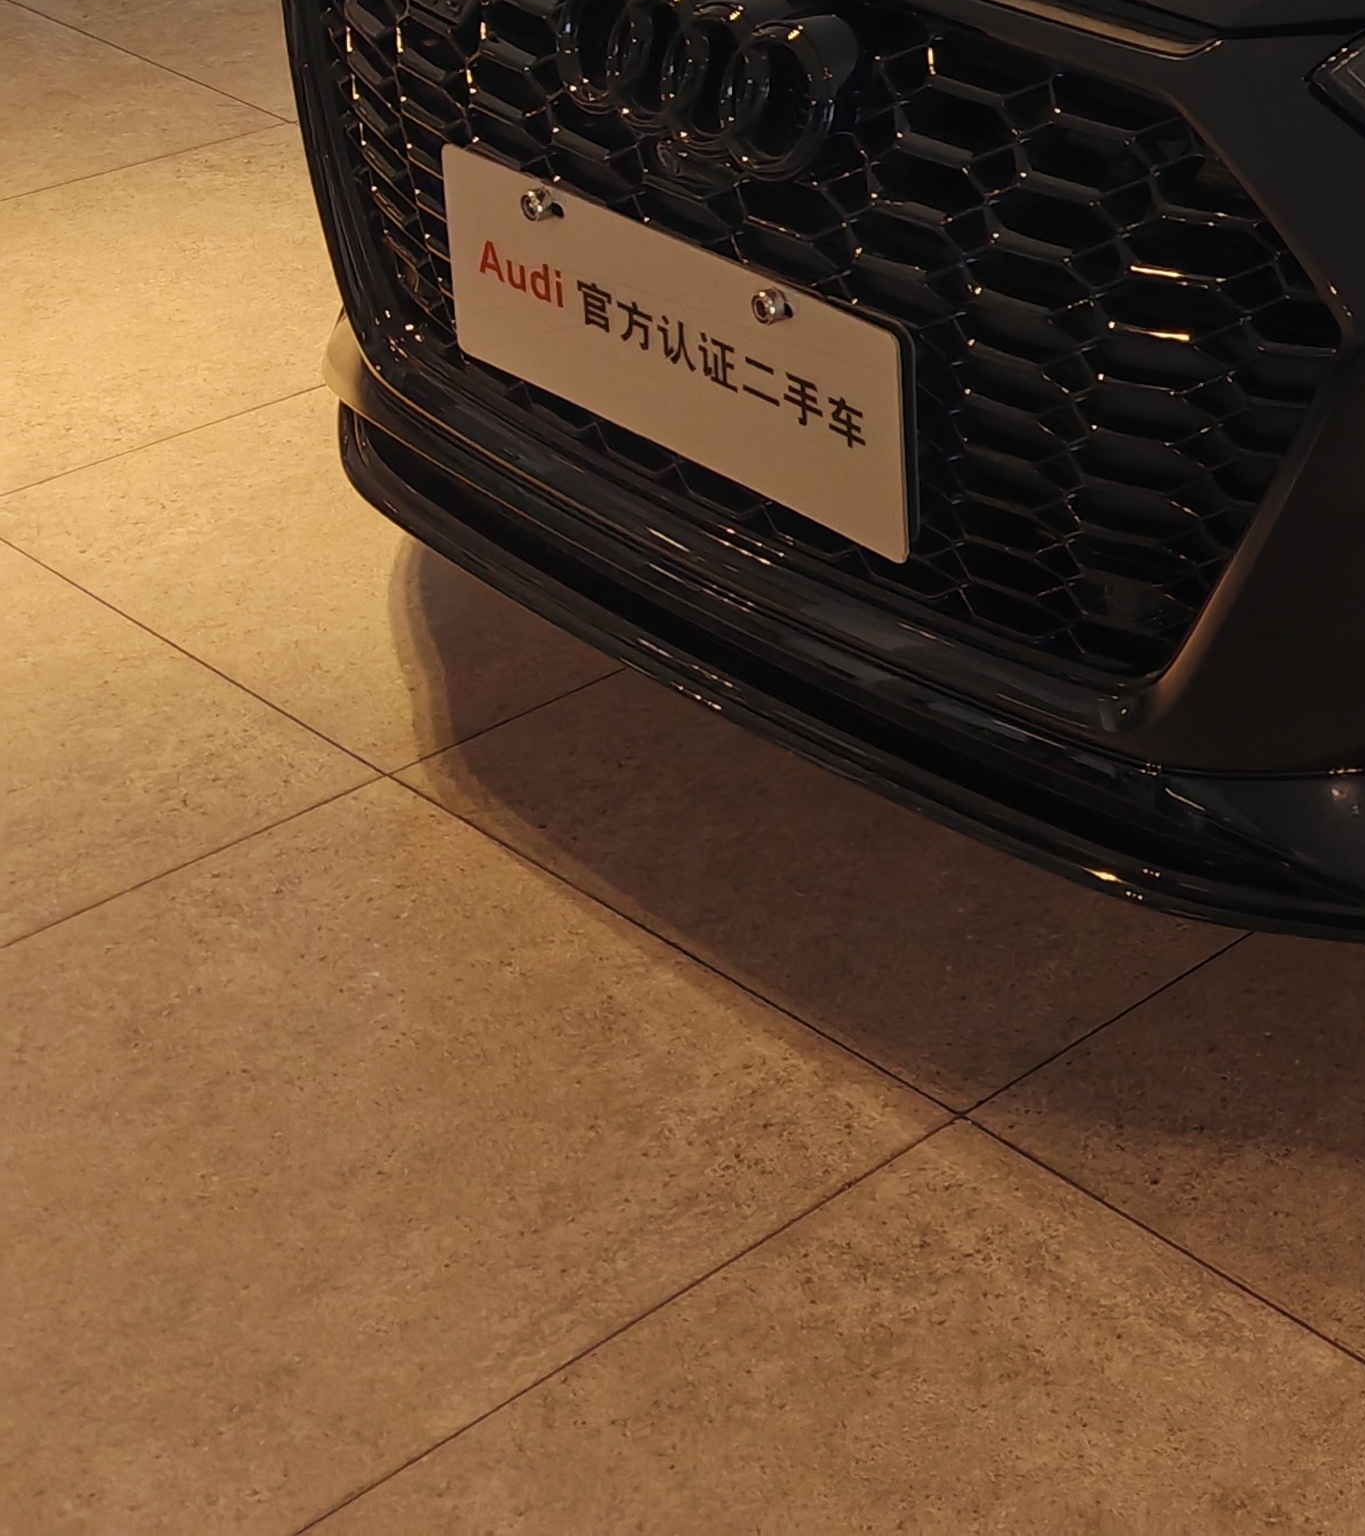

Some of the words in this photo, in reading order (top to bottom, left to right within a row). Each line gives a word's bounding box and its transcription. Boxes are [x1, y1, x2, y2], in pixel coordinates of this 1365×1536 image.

[479, 240, 564, 308] Audi
[576, 279, 866, 449] 官方认证二手车
